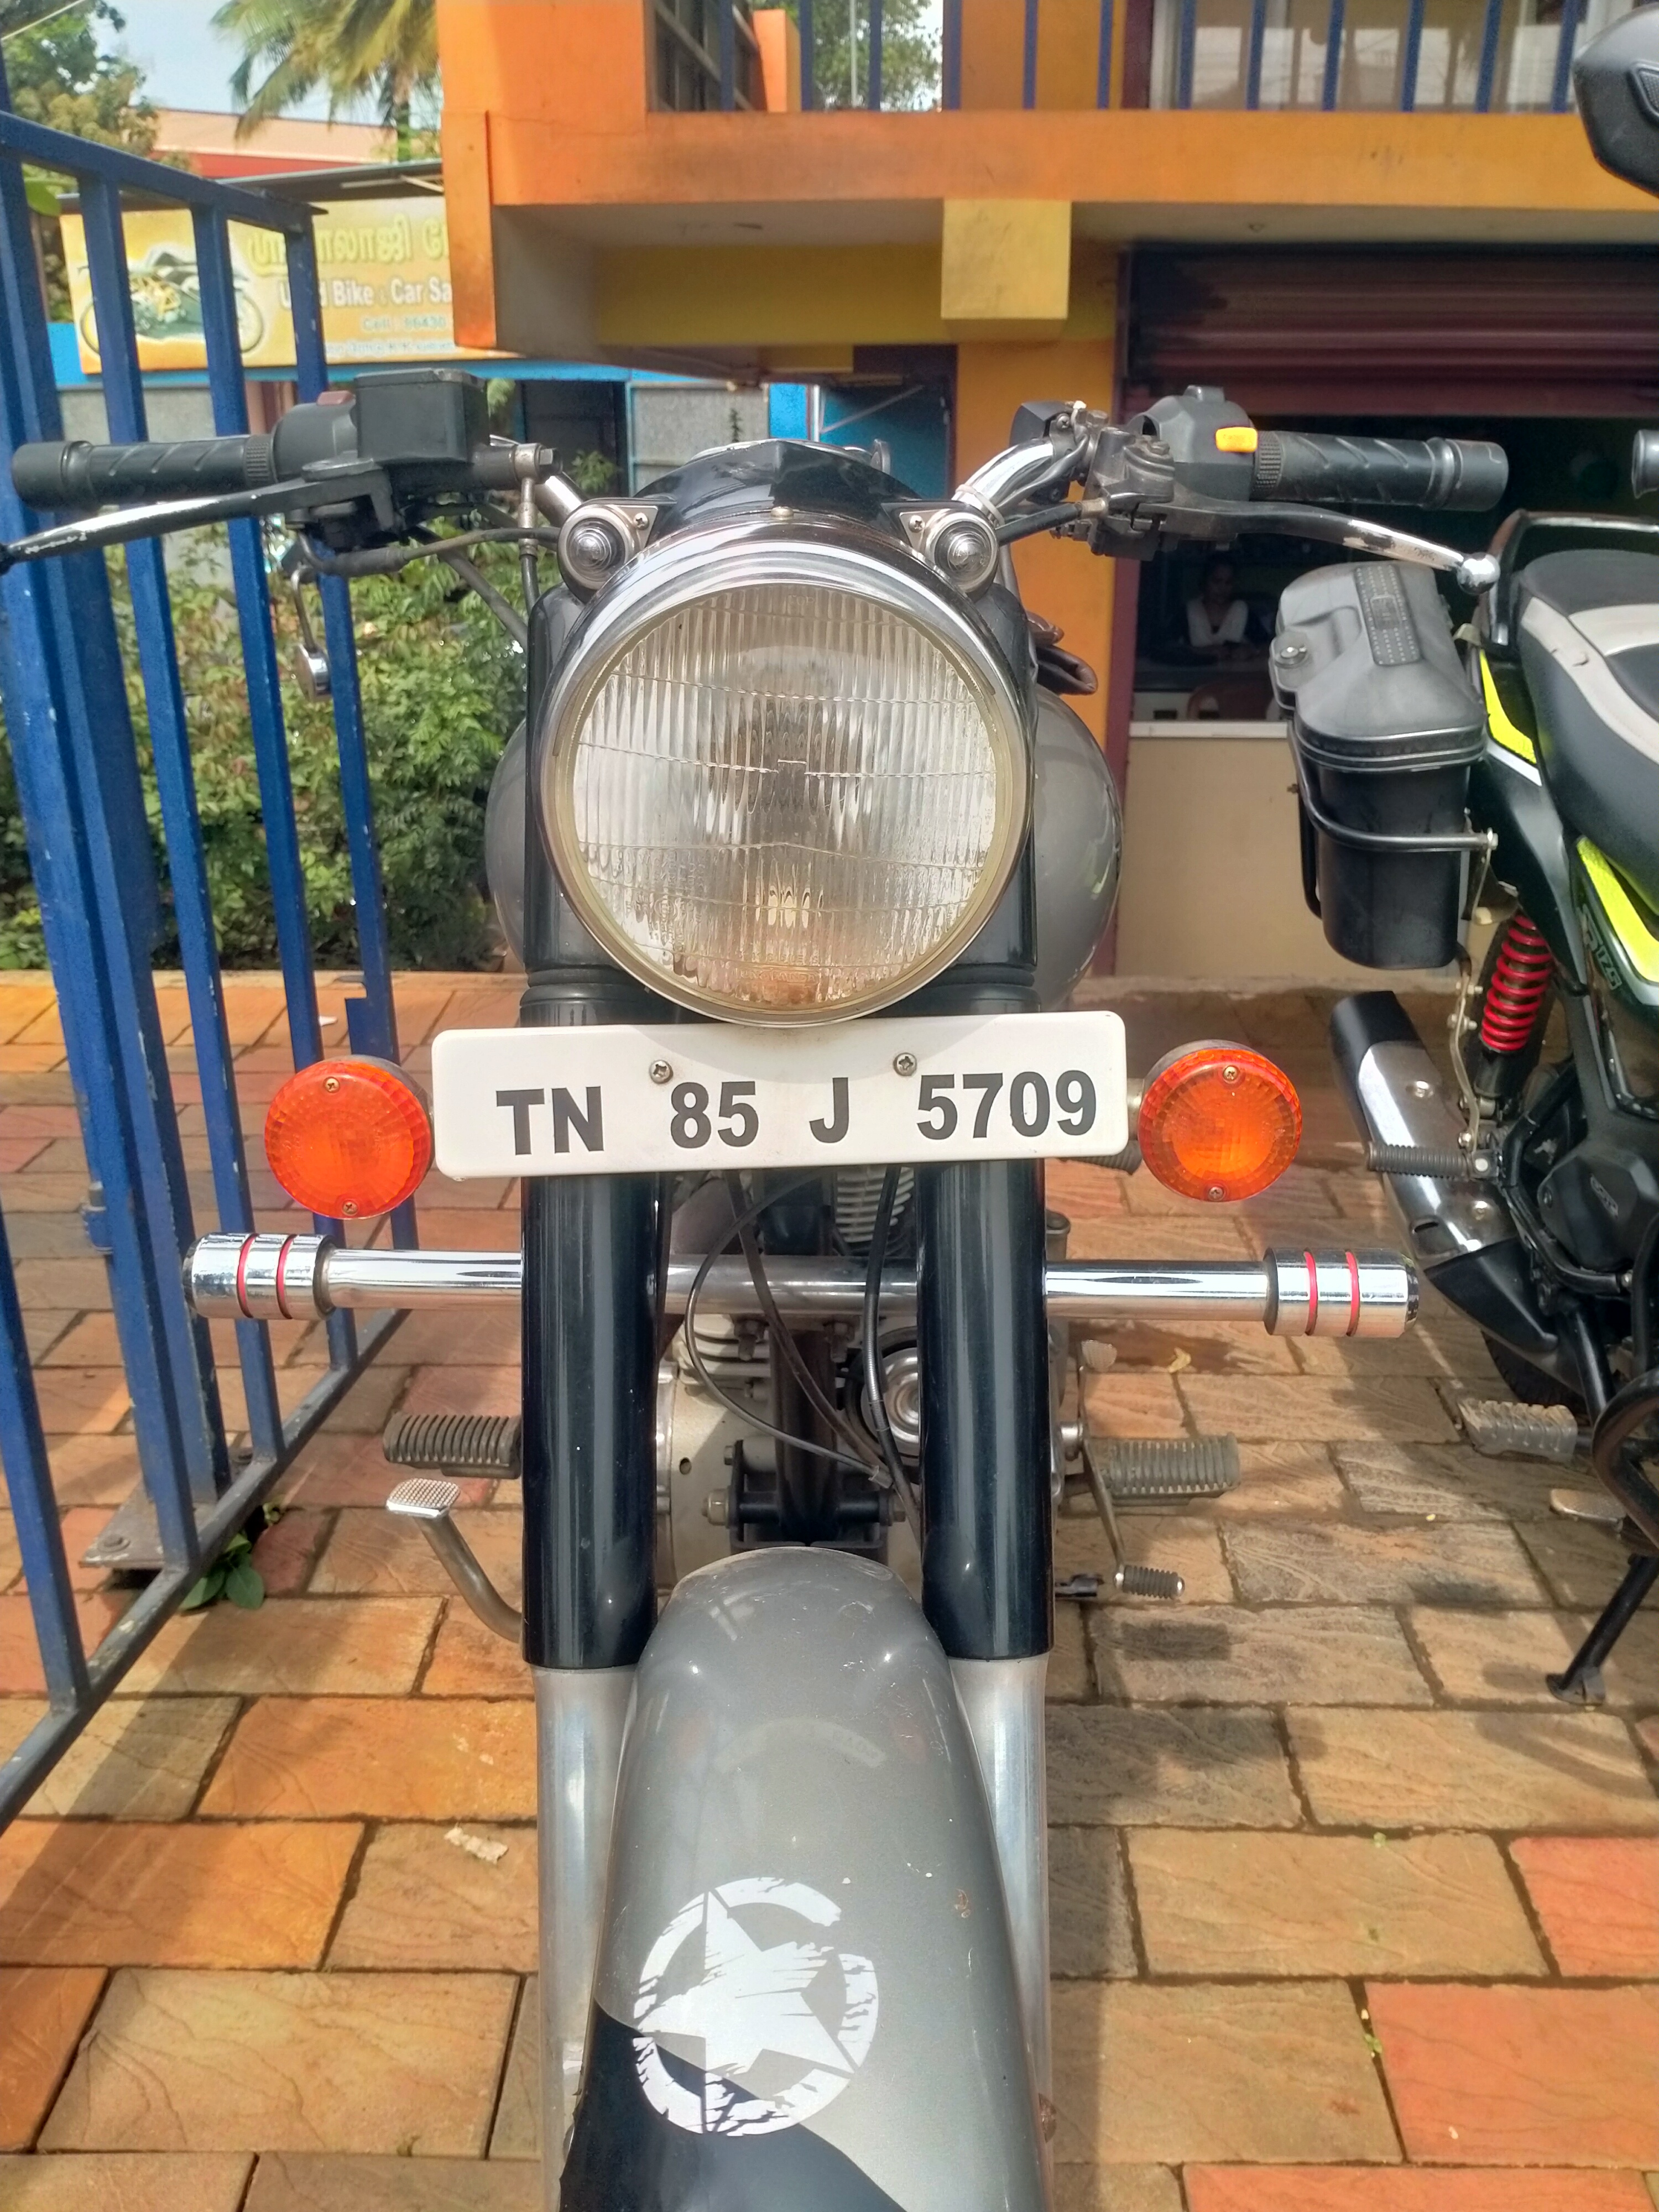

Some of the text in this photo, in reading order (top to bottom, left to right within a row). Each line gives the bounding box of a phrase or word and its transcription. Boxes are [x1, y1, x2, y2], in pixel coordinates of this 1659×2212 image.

[332, 279, 374, 307] Bike
[391, 278, 424, 304] Car
[497, 1071, 1096, 1155] TN 85 J 5709
